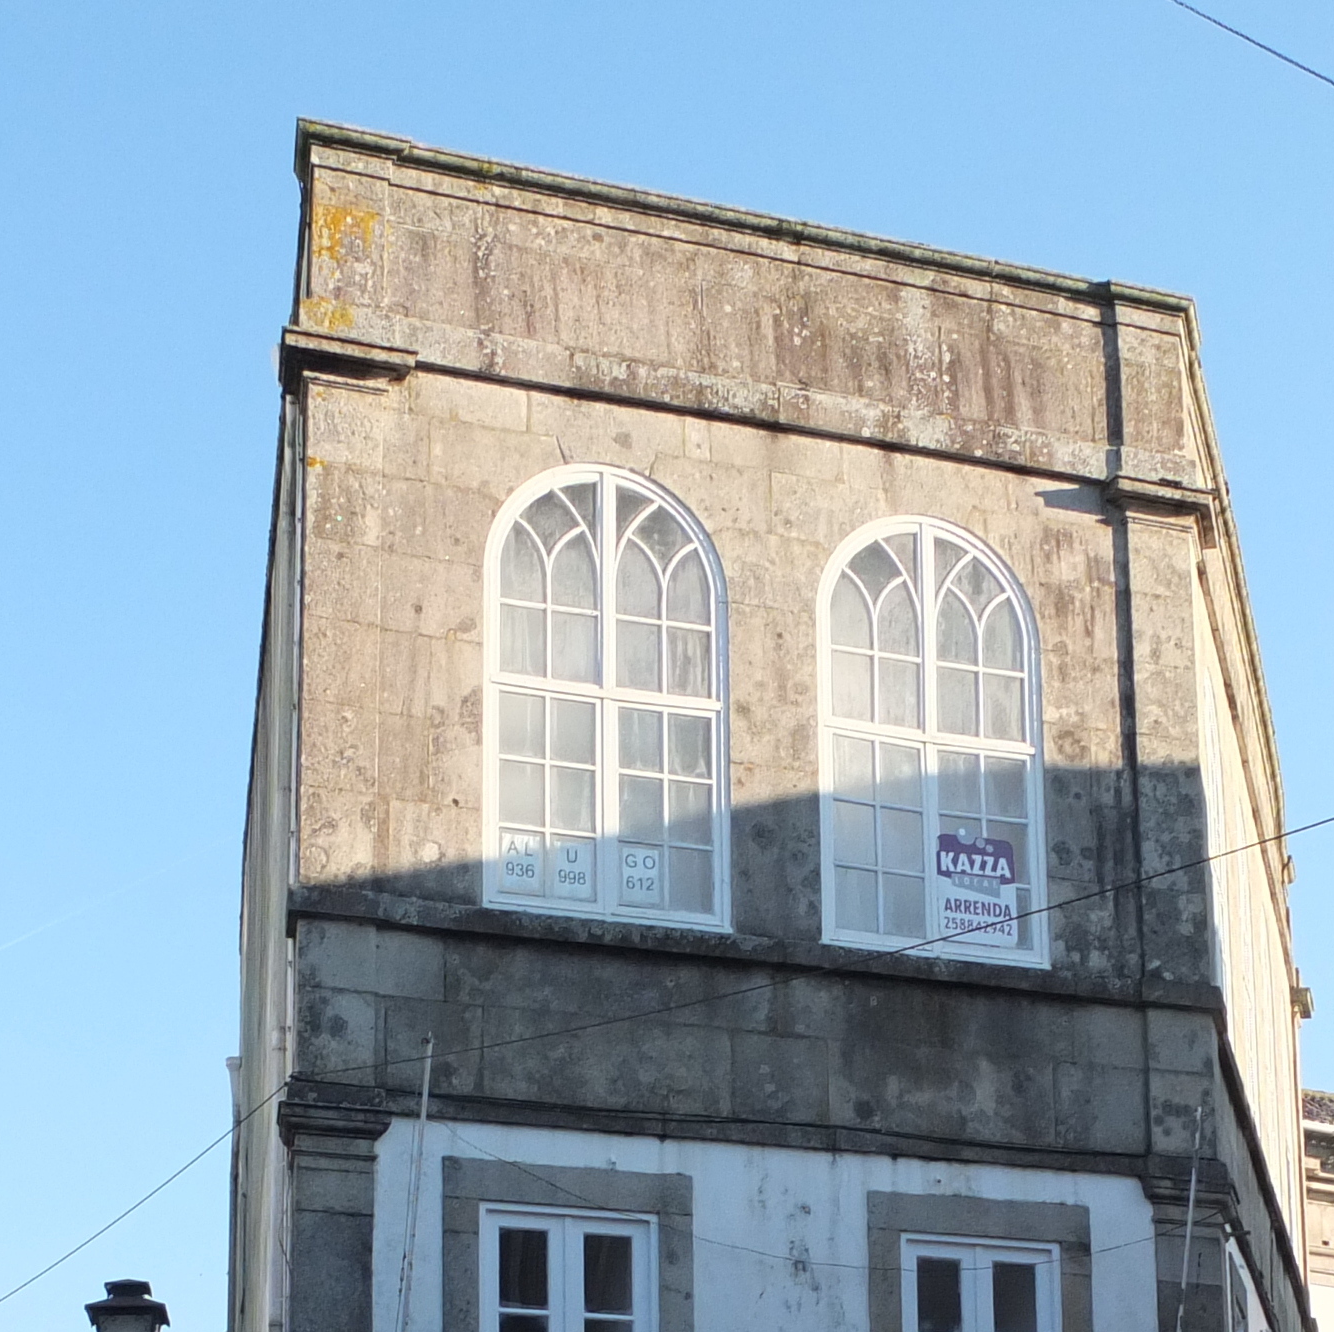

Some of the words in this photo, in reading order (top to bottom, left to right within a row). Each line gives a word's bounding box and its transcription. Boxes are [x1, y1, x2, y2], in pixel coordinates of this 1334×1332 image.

[505, 861, 535, 879] 936
[558, 869, 587, 886] 998
[625, 875, 655, 892] 612
[939, 850, 1012, 879] KAZZA
[944, 897, 1013, 919] ARRENDA
